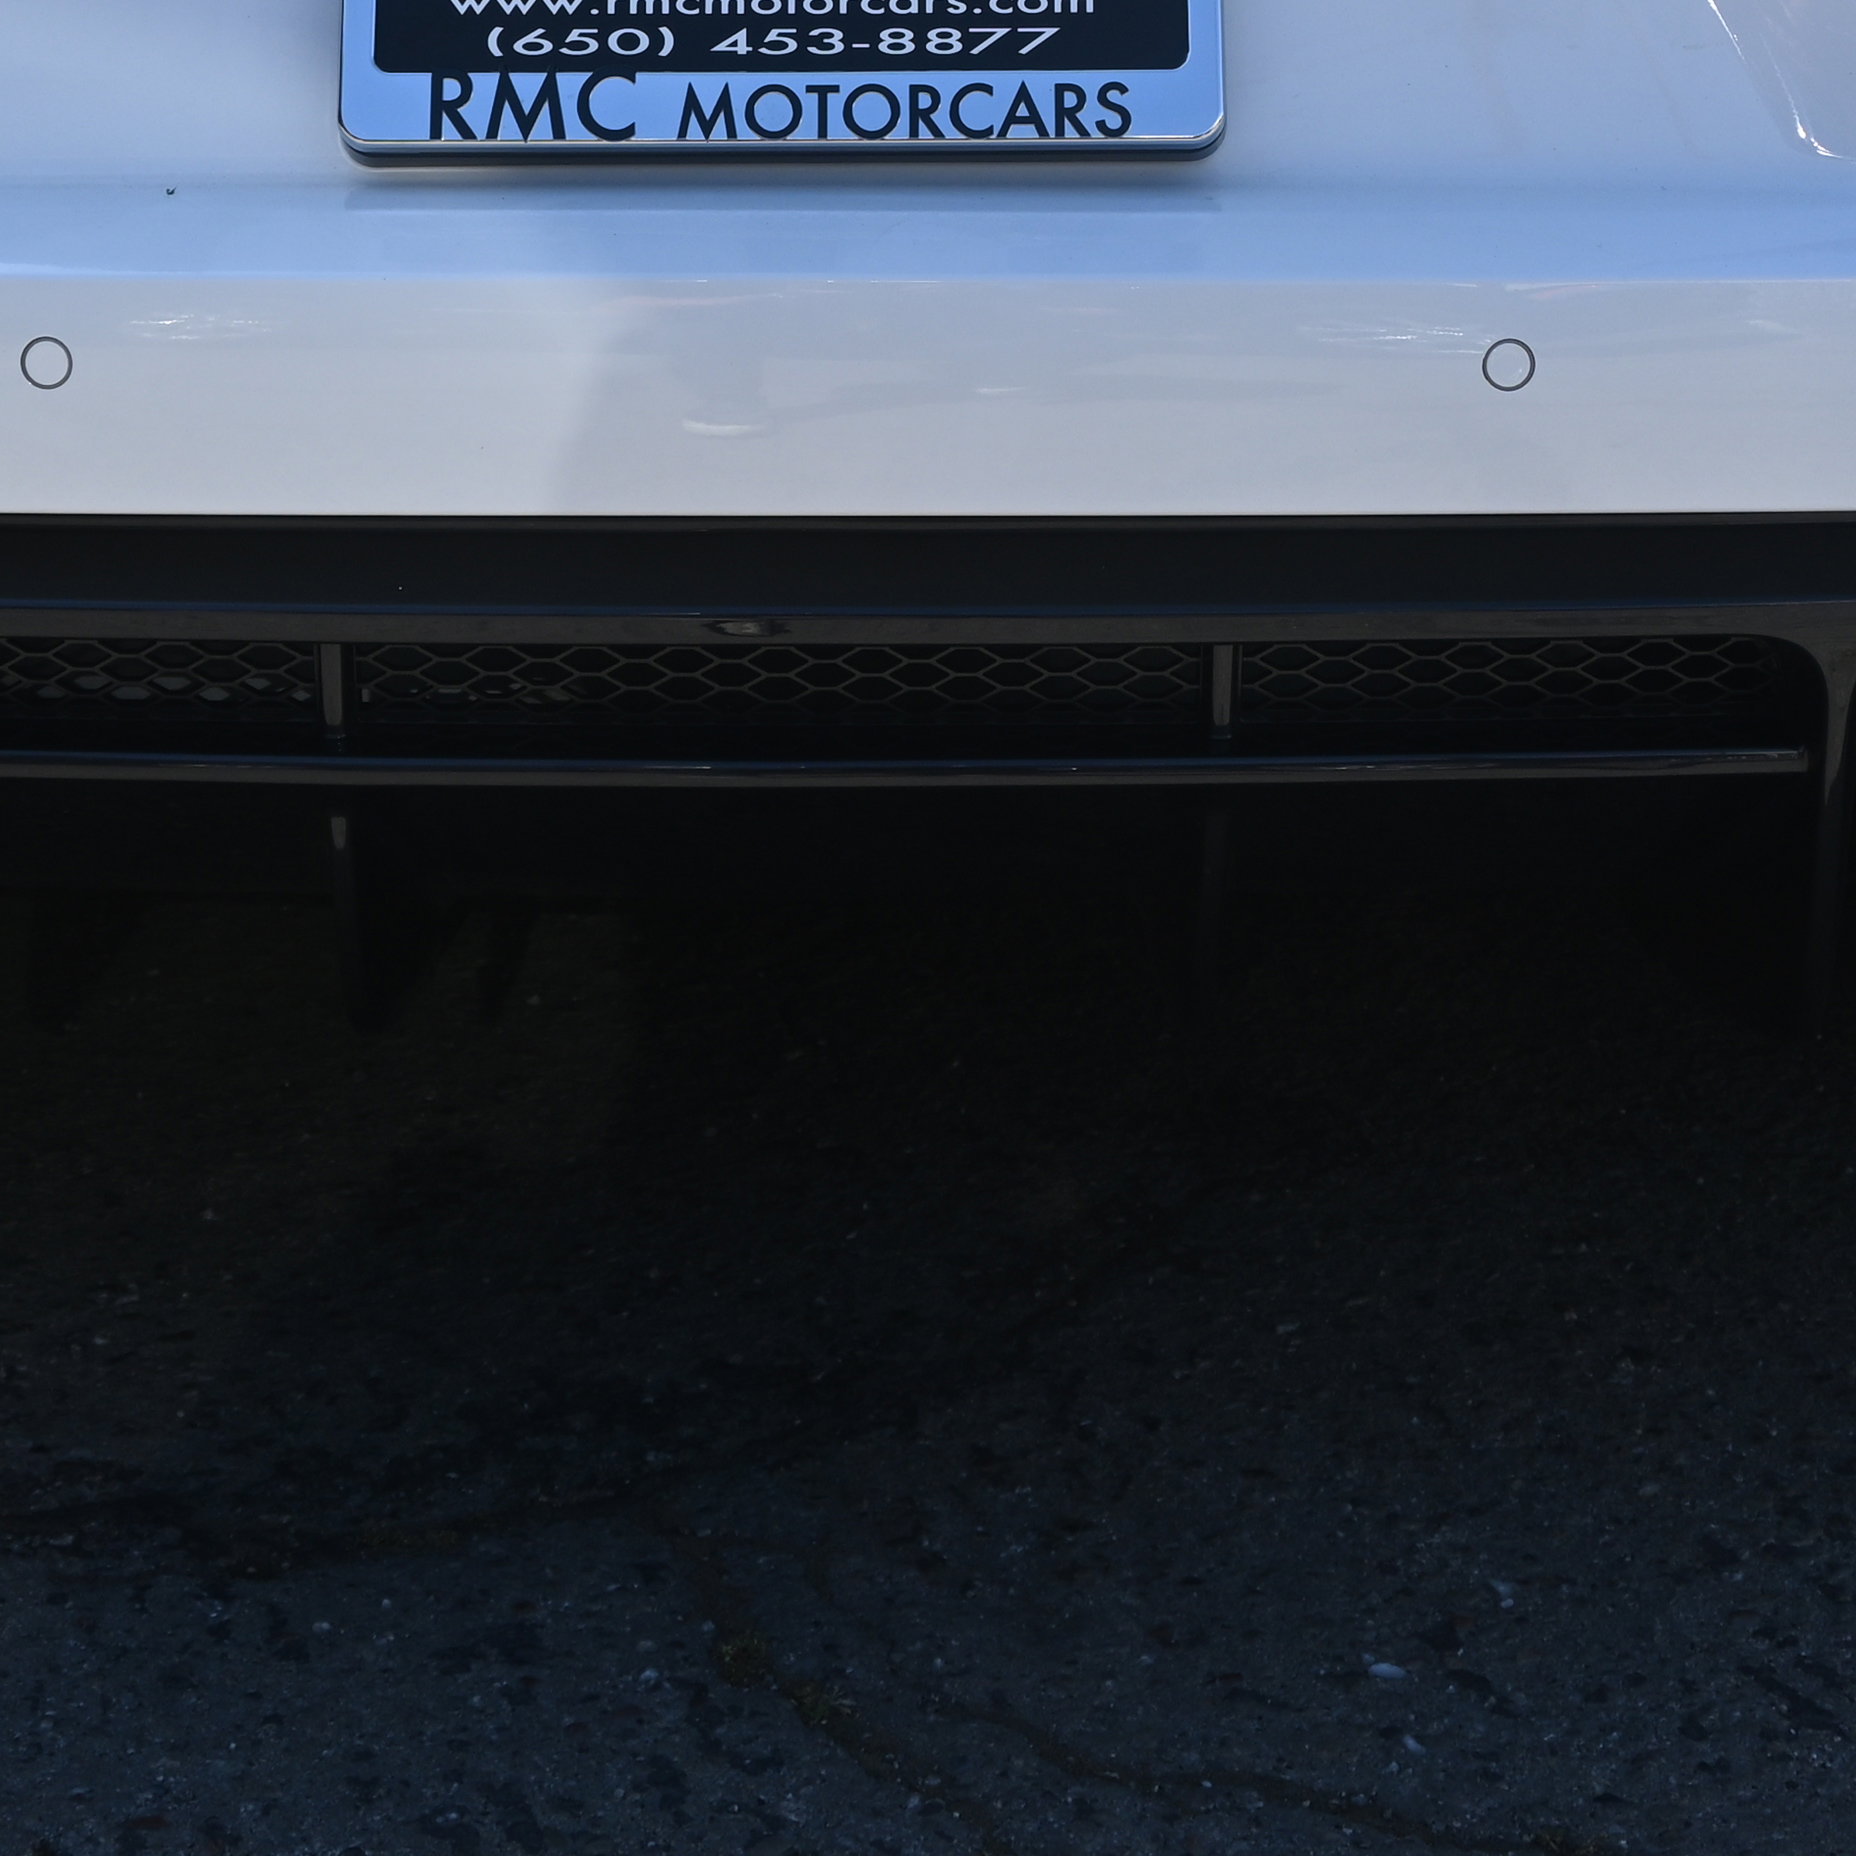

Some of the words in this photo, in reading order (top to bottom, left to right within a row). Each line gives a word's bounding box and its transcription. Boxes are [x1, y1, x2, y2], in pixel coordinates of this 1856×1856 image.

[486, 26, 675, 57] (650)
[710, 27, 1061, 56] 453-8877
[430, 70, 637, 142] RMC
[677, 80, 1132, 140] MOTORCARS
